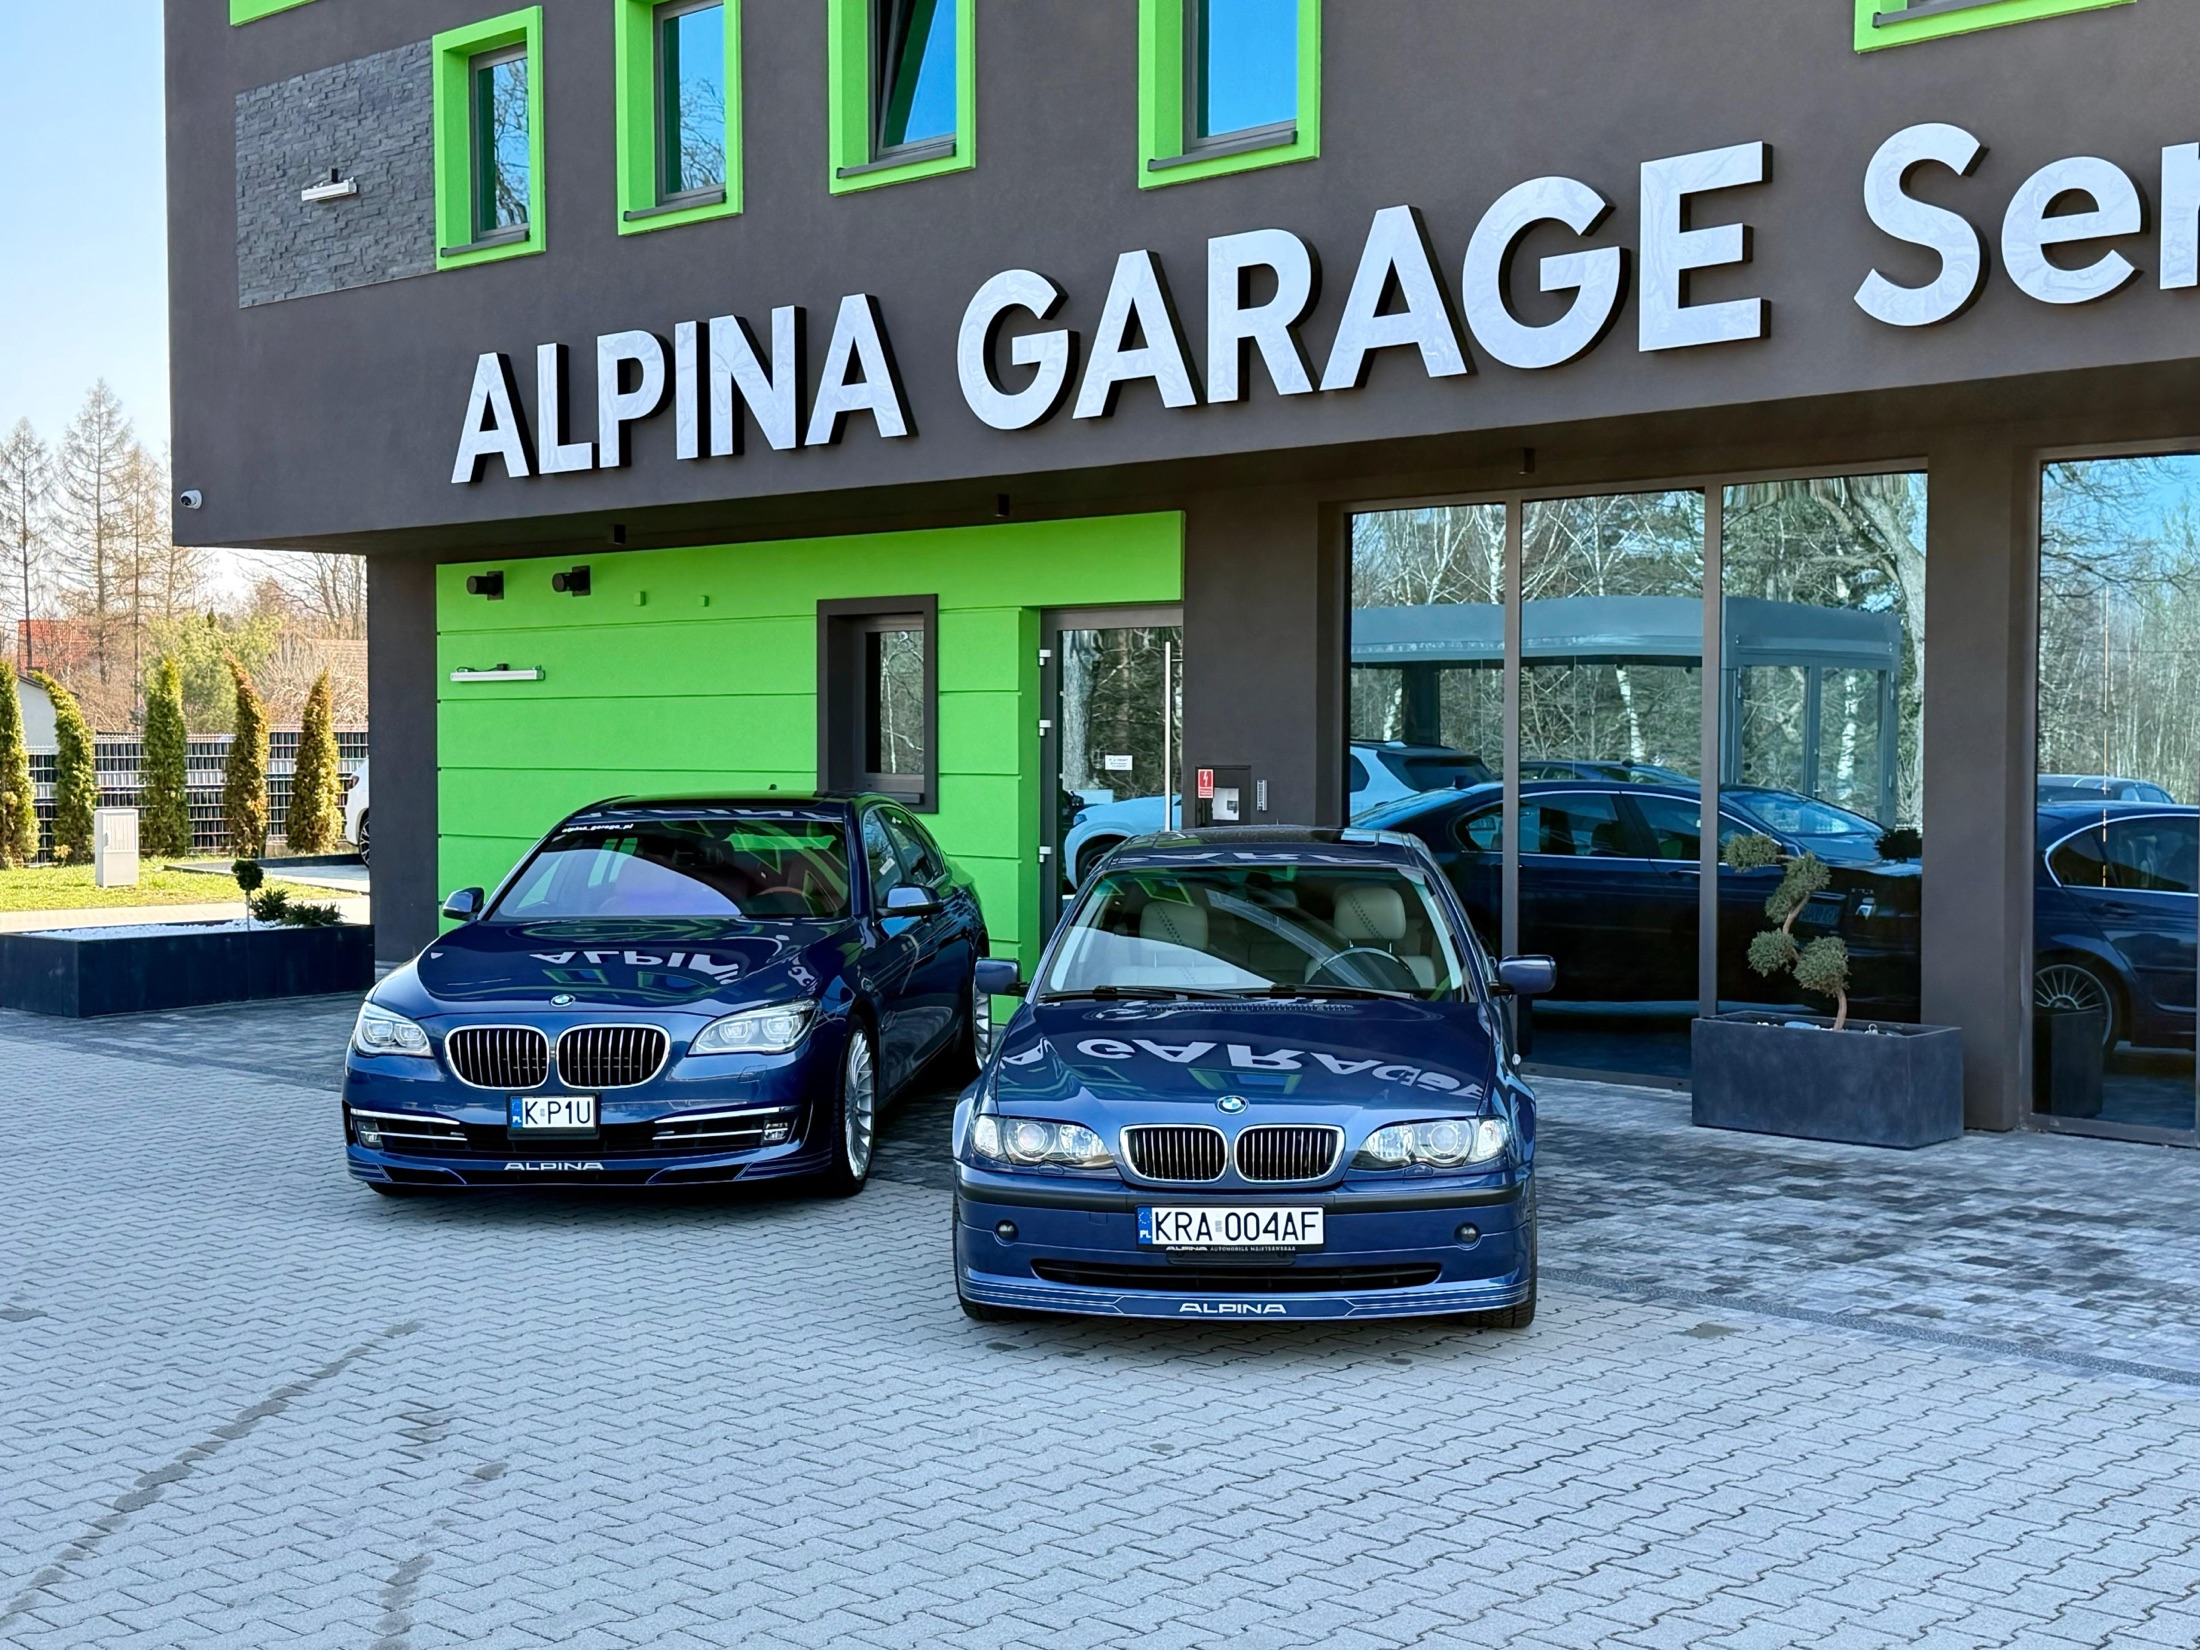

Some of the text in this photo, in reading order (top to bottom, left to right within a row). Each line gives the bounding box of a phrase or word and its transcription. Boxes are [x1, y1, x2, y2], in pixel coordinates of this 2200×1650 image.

[450, 292, 914, 485] ALPINA
[957, 139, 1770, 431] GARAGE
[503, 1162, 605, 1171] ALPINA
[1154, 1211, 1319, 1242] KRA 004AF
[1139, 1229, 1152, 1239] PL
[1179, 1302, 1287, 1314] ALPINA
